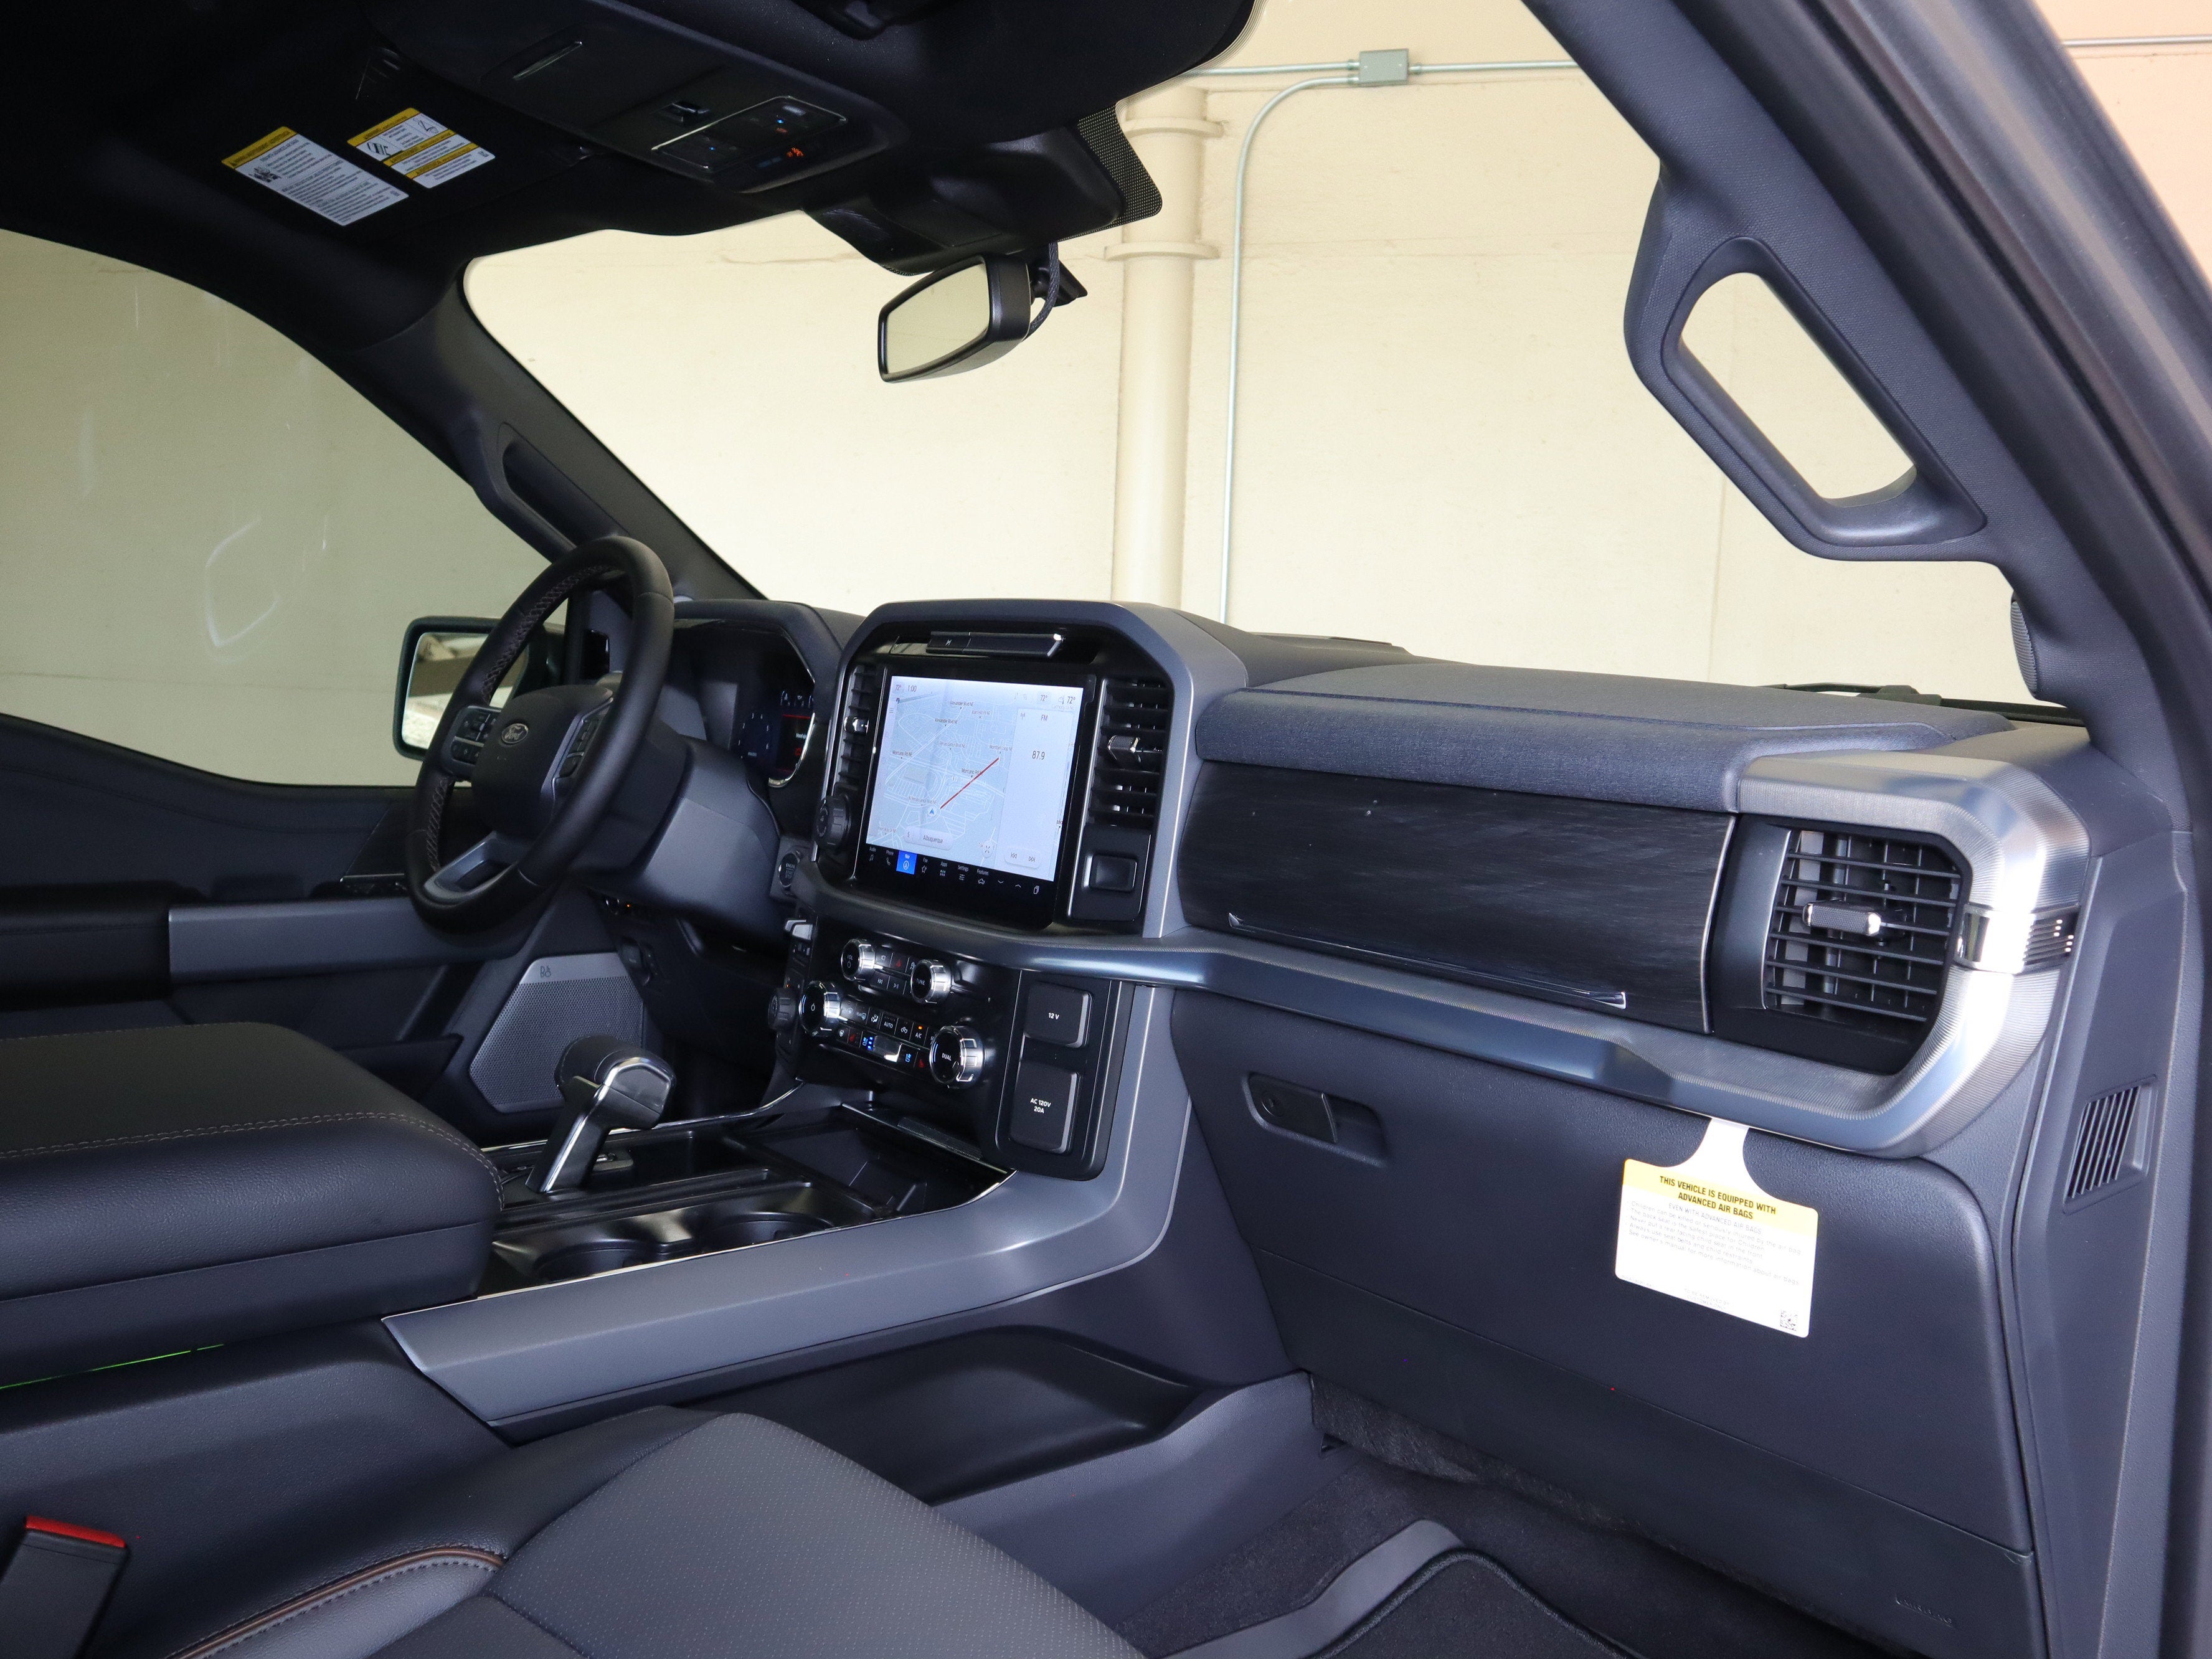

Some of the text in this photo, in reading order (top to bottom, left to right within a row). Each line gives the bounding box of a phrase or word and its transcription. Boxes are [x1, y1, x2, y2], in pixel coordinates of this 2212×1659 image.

[1066, 695, 1076, 704] 72°
[504, 726, 525, 741] Ford
[1031, 750, 1046, 760] 87.9
[922, 834, 943, 844] Albuquerque
[958, 864, 970, 872] Settings
[976, 868, 989, 876] Features
[942, 1052, 952, 1061] DUAL
[1038, 1100, 1051, 1108] 120V
[1659, 1175, 1777, 1214] THIS VEHICLE IS EQUIPPED WITH
[1678, 1191, 1754, 1219] ADVANCED AIR BAGS
[1668, 1203, 1762, 1234] EVEN WITH ADVANCED AIR BAGS
